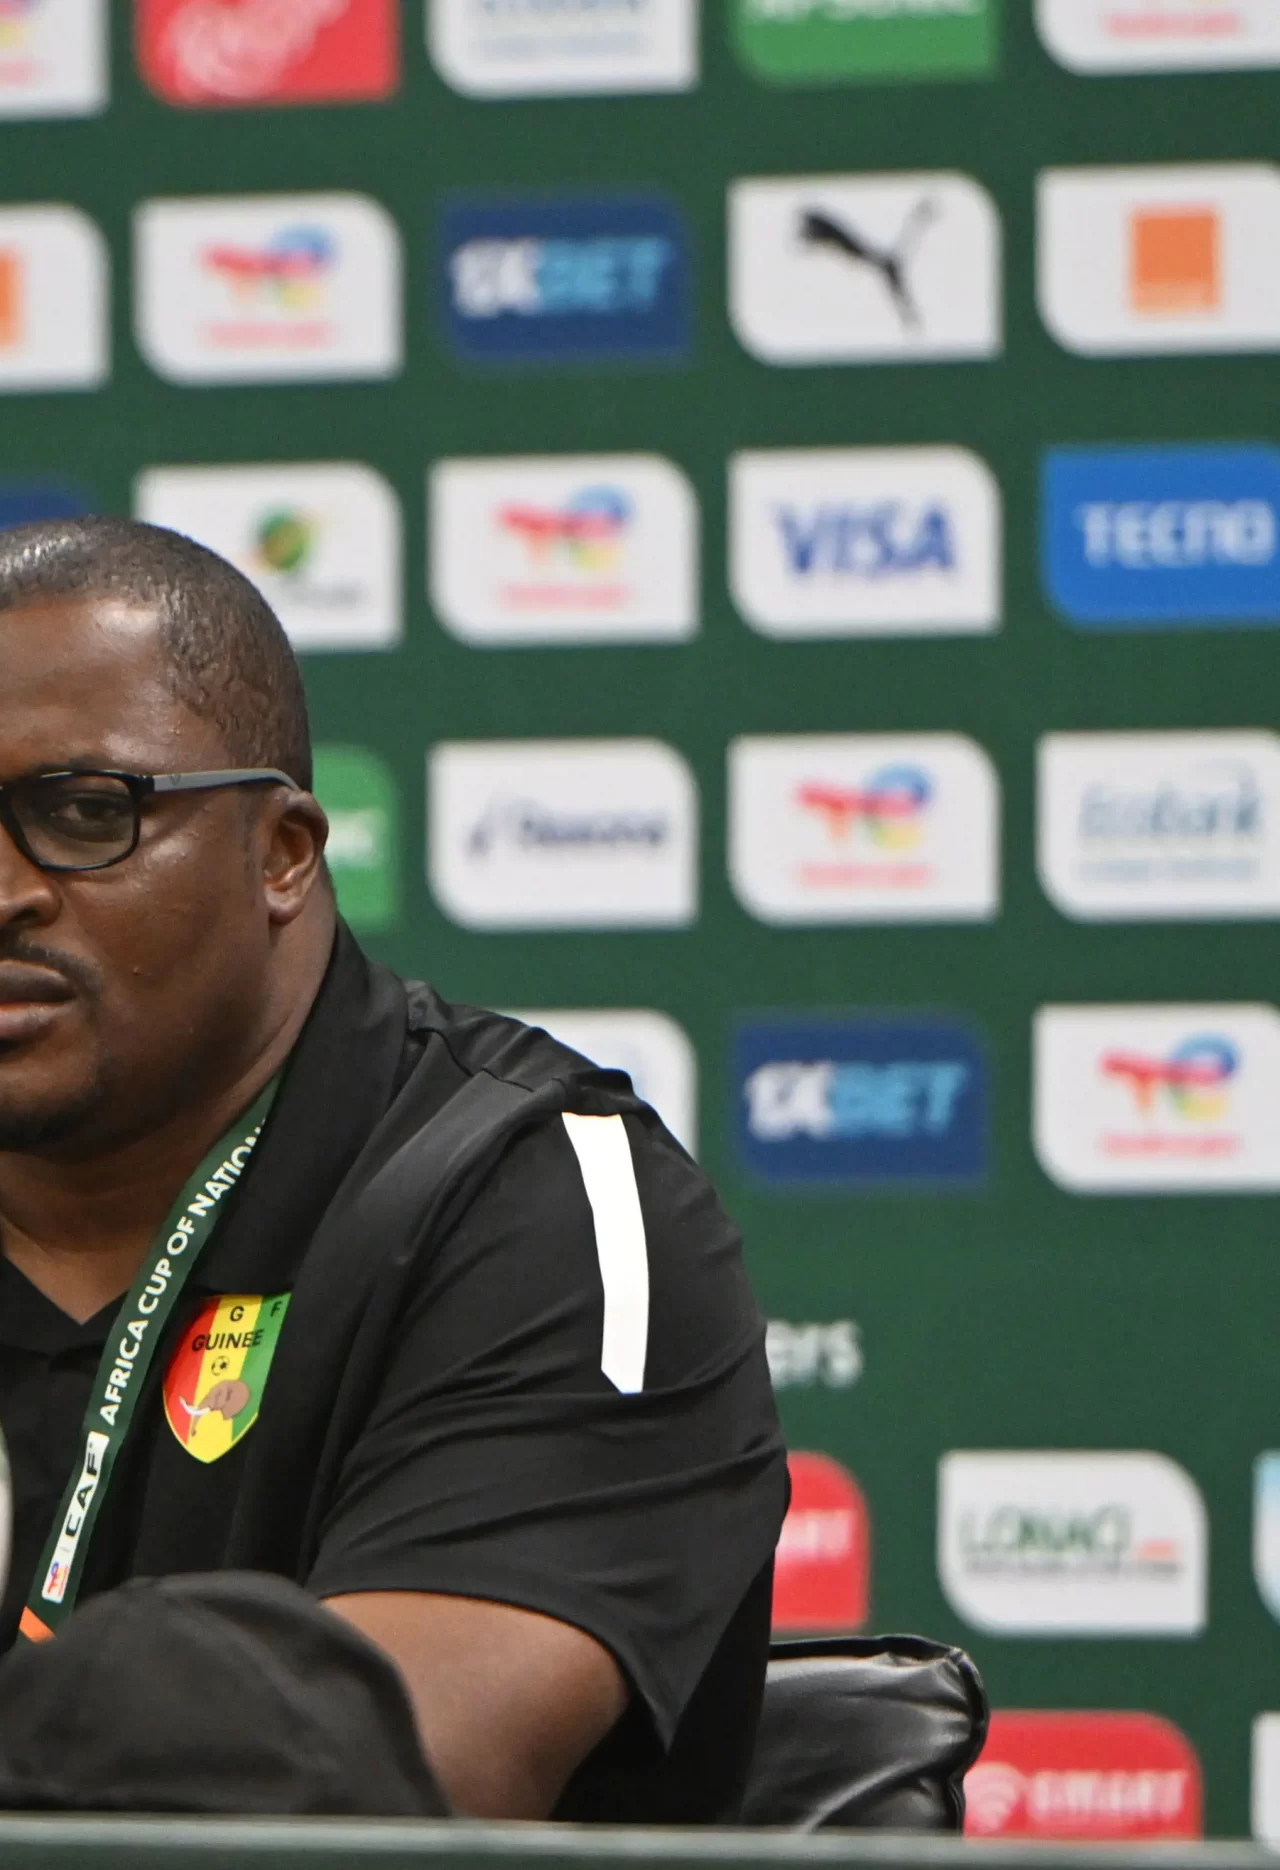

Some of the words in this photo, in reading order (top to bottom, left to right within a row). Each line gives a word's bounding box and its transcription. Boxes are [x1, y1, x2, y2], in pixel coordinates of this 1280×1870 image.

[773, 500, 957, 577] VISA
[1078, 500, 1276, 568] TECNO
[99, 1320, 149, 1426] AFRICA
[138, 1258, 172, 1314] CUP
[166, 1216, 195, 1256] OF
[187, 1118, 267, 1217] NATIO
[191, 1328, 265, 1352] GUINEE
[230, 1305, 245, 1322] G
[270, 1301, 282, 1317] F
[65, 1451, 98, 1537] CAF
